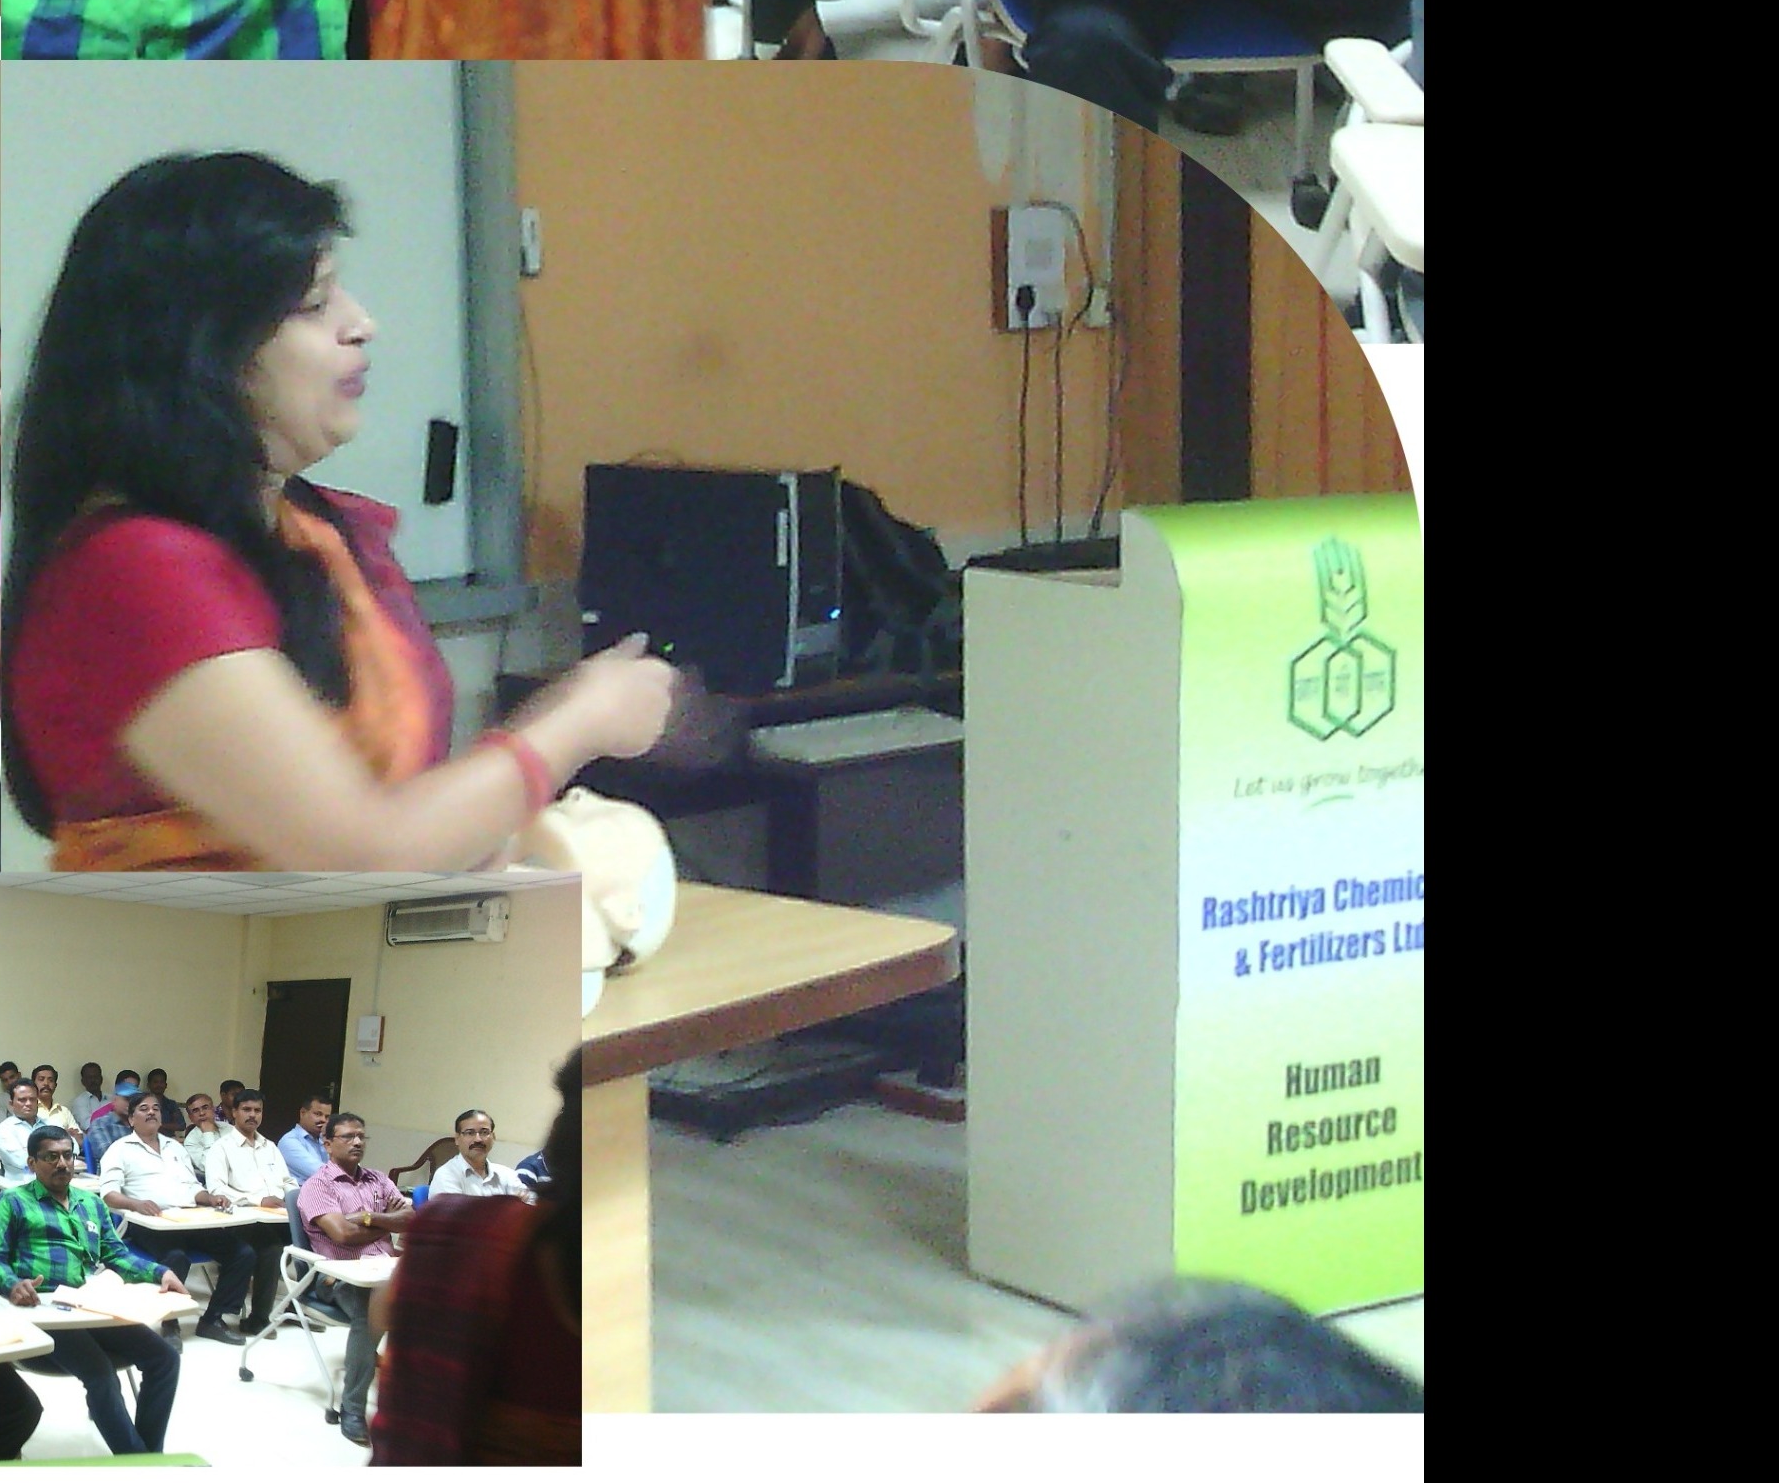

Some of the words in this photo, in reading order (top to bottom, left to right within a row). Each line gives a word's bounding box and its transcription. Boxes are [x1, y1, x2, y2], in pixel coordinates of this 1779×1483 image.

[1201, 884, 1326, 931] Rashtriya
[1234, 947, 1252, 978] &
[1258, 929, 1386, 974] Fertilizers
[1285, 1055, 1381, 1099] Human
[1267, 1105, 1397, 1156] Resource
[1240, 1150, 1423, 1216] Development
